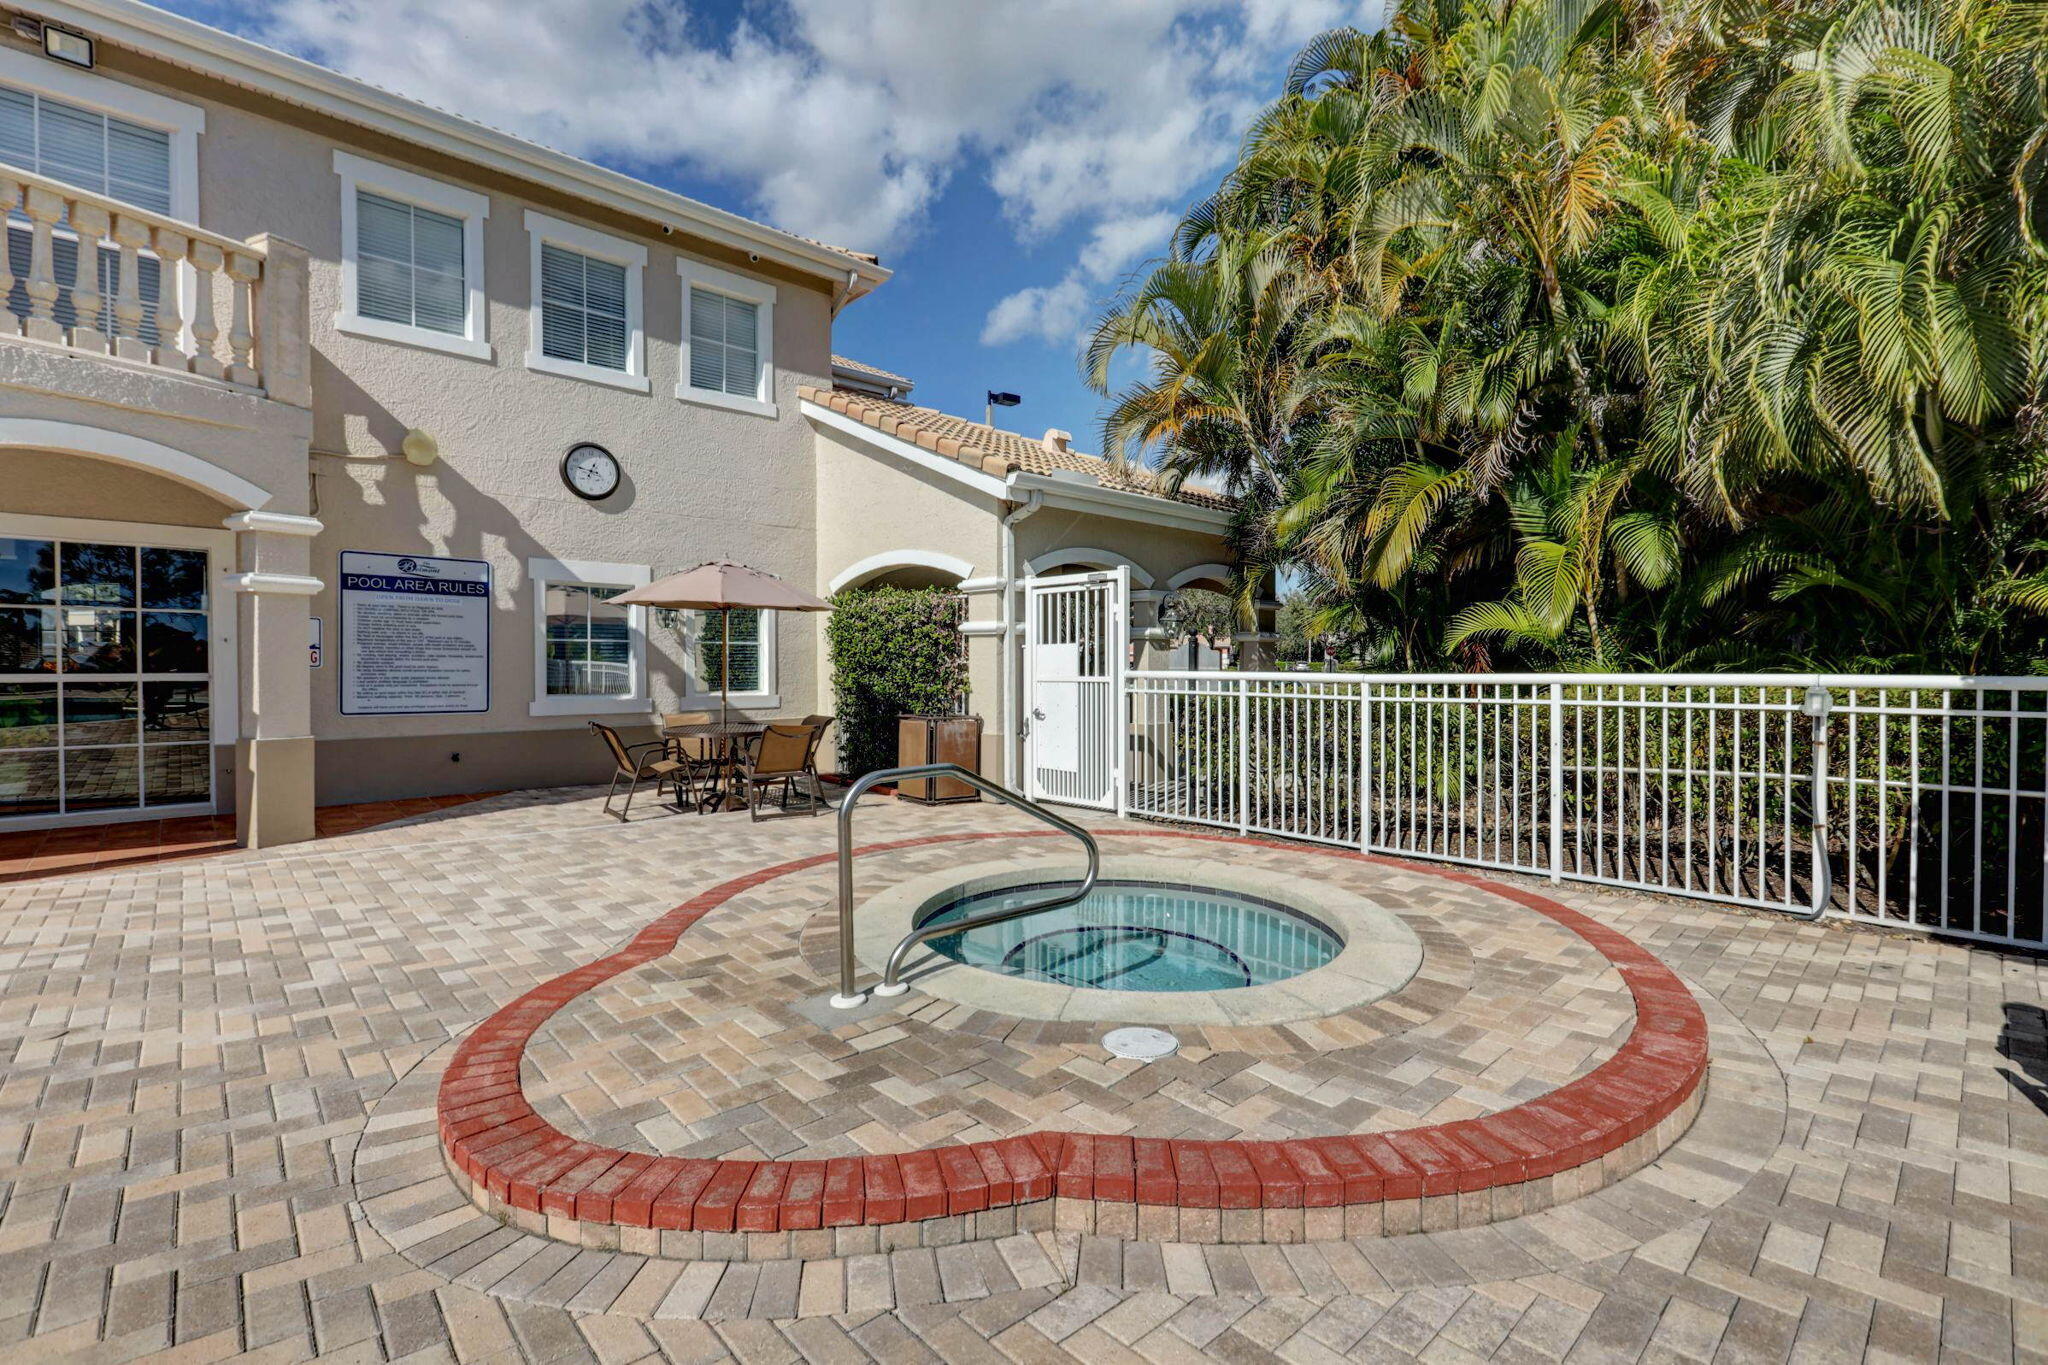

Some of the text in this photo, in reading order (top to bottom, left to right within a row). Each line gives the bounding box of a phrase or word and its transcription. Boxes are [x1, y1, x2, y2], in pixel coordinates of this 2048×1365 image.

[347, 576, 485, 595] POOL AREA RULES
